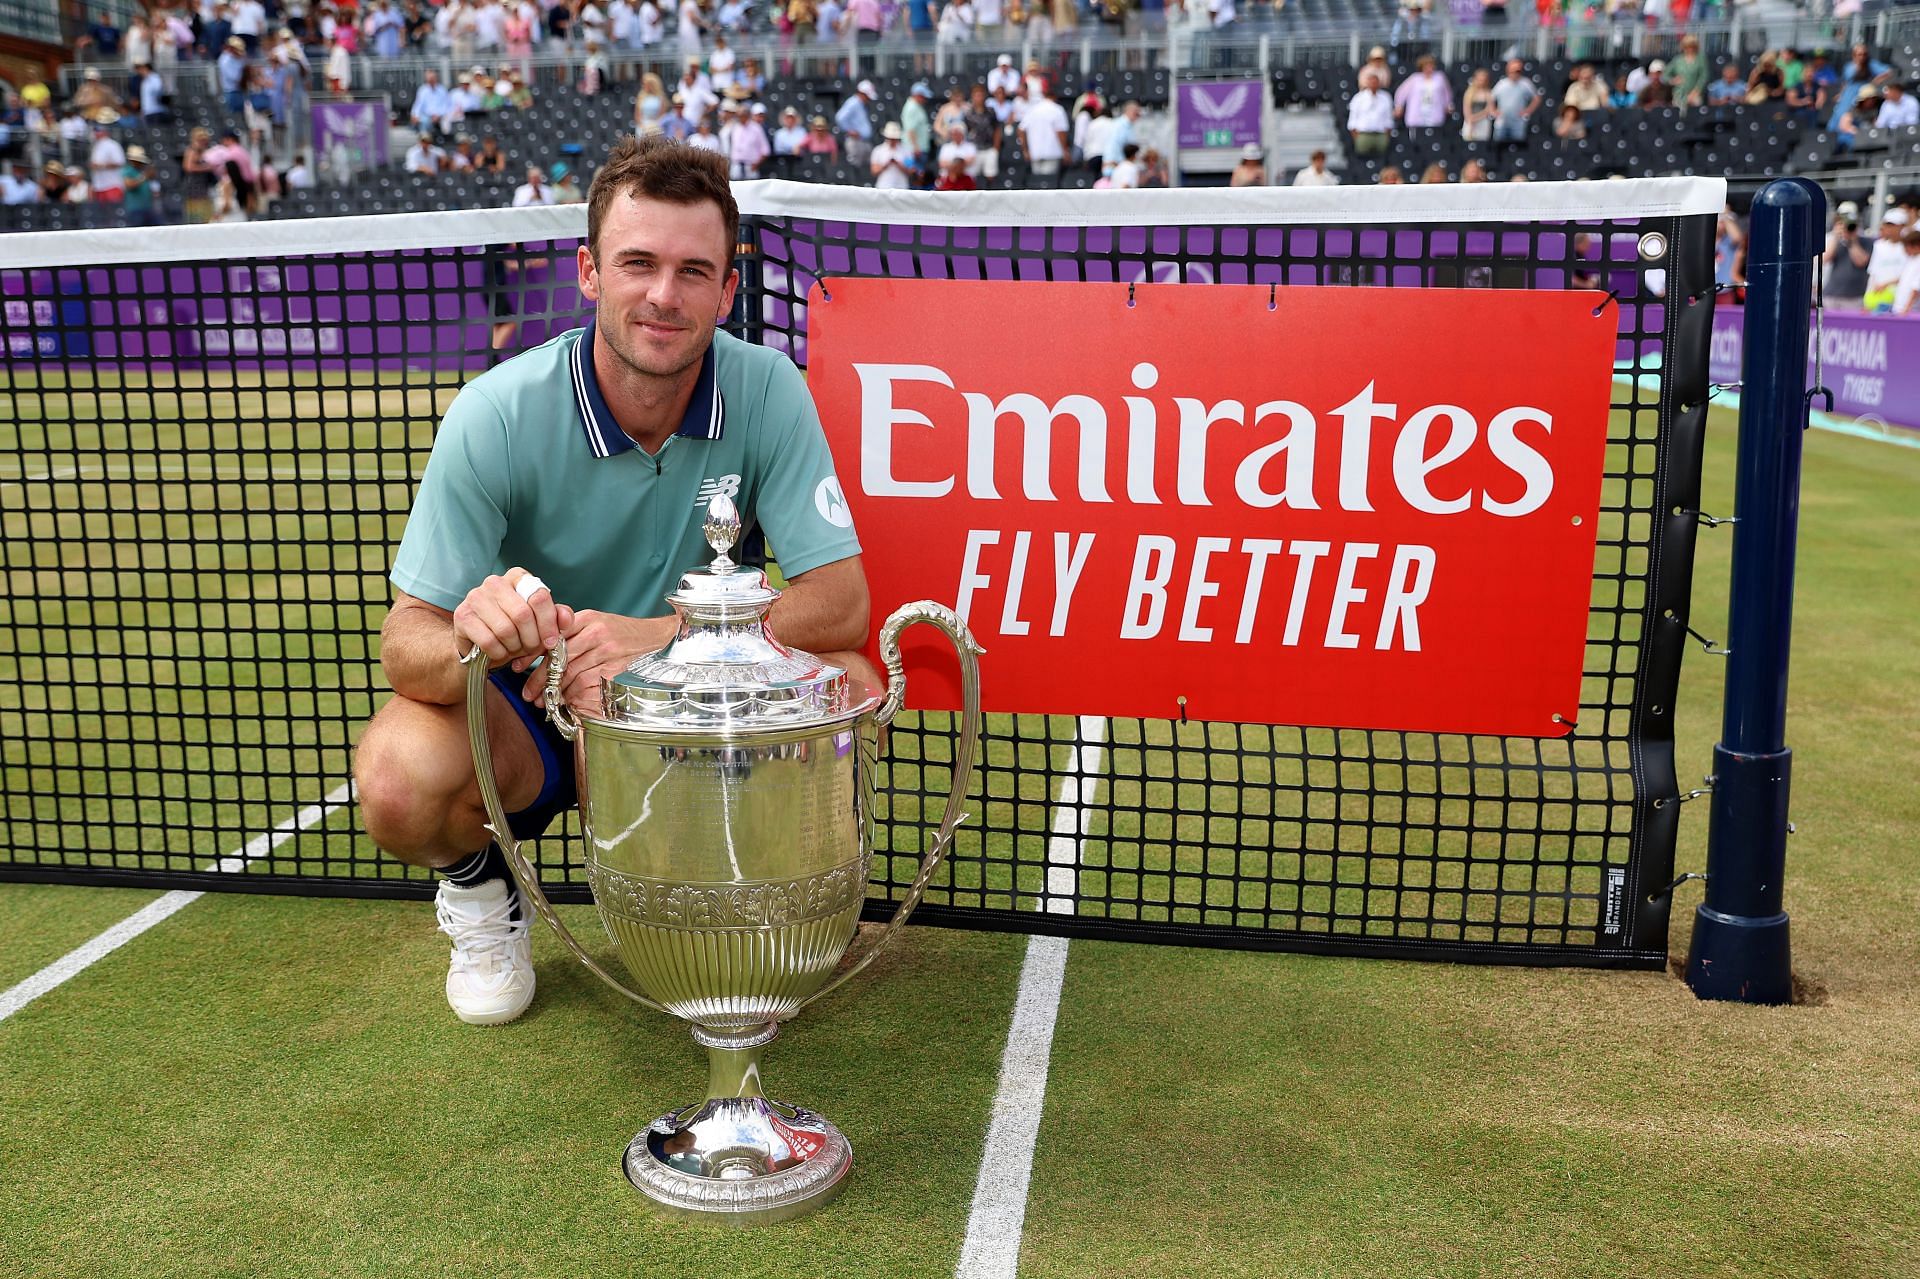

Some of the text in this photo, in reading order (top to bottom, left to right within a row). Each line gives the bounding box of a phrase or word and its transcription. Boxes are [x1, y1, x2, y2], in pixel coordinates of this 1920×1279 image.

[1808, 327, 1887, 371] OKOHAMA
[1842, 373, 1885, 406] TYRES
[853, 363, 1553, 517] Emirates
[957, 530, 1436, 652] FLY BETTER
